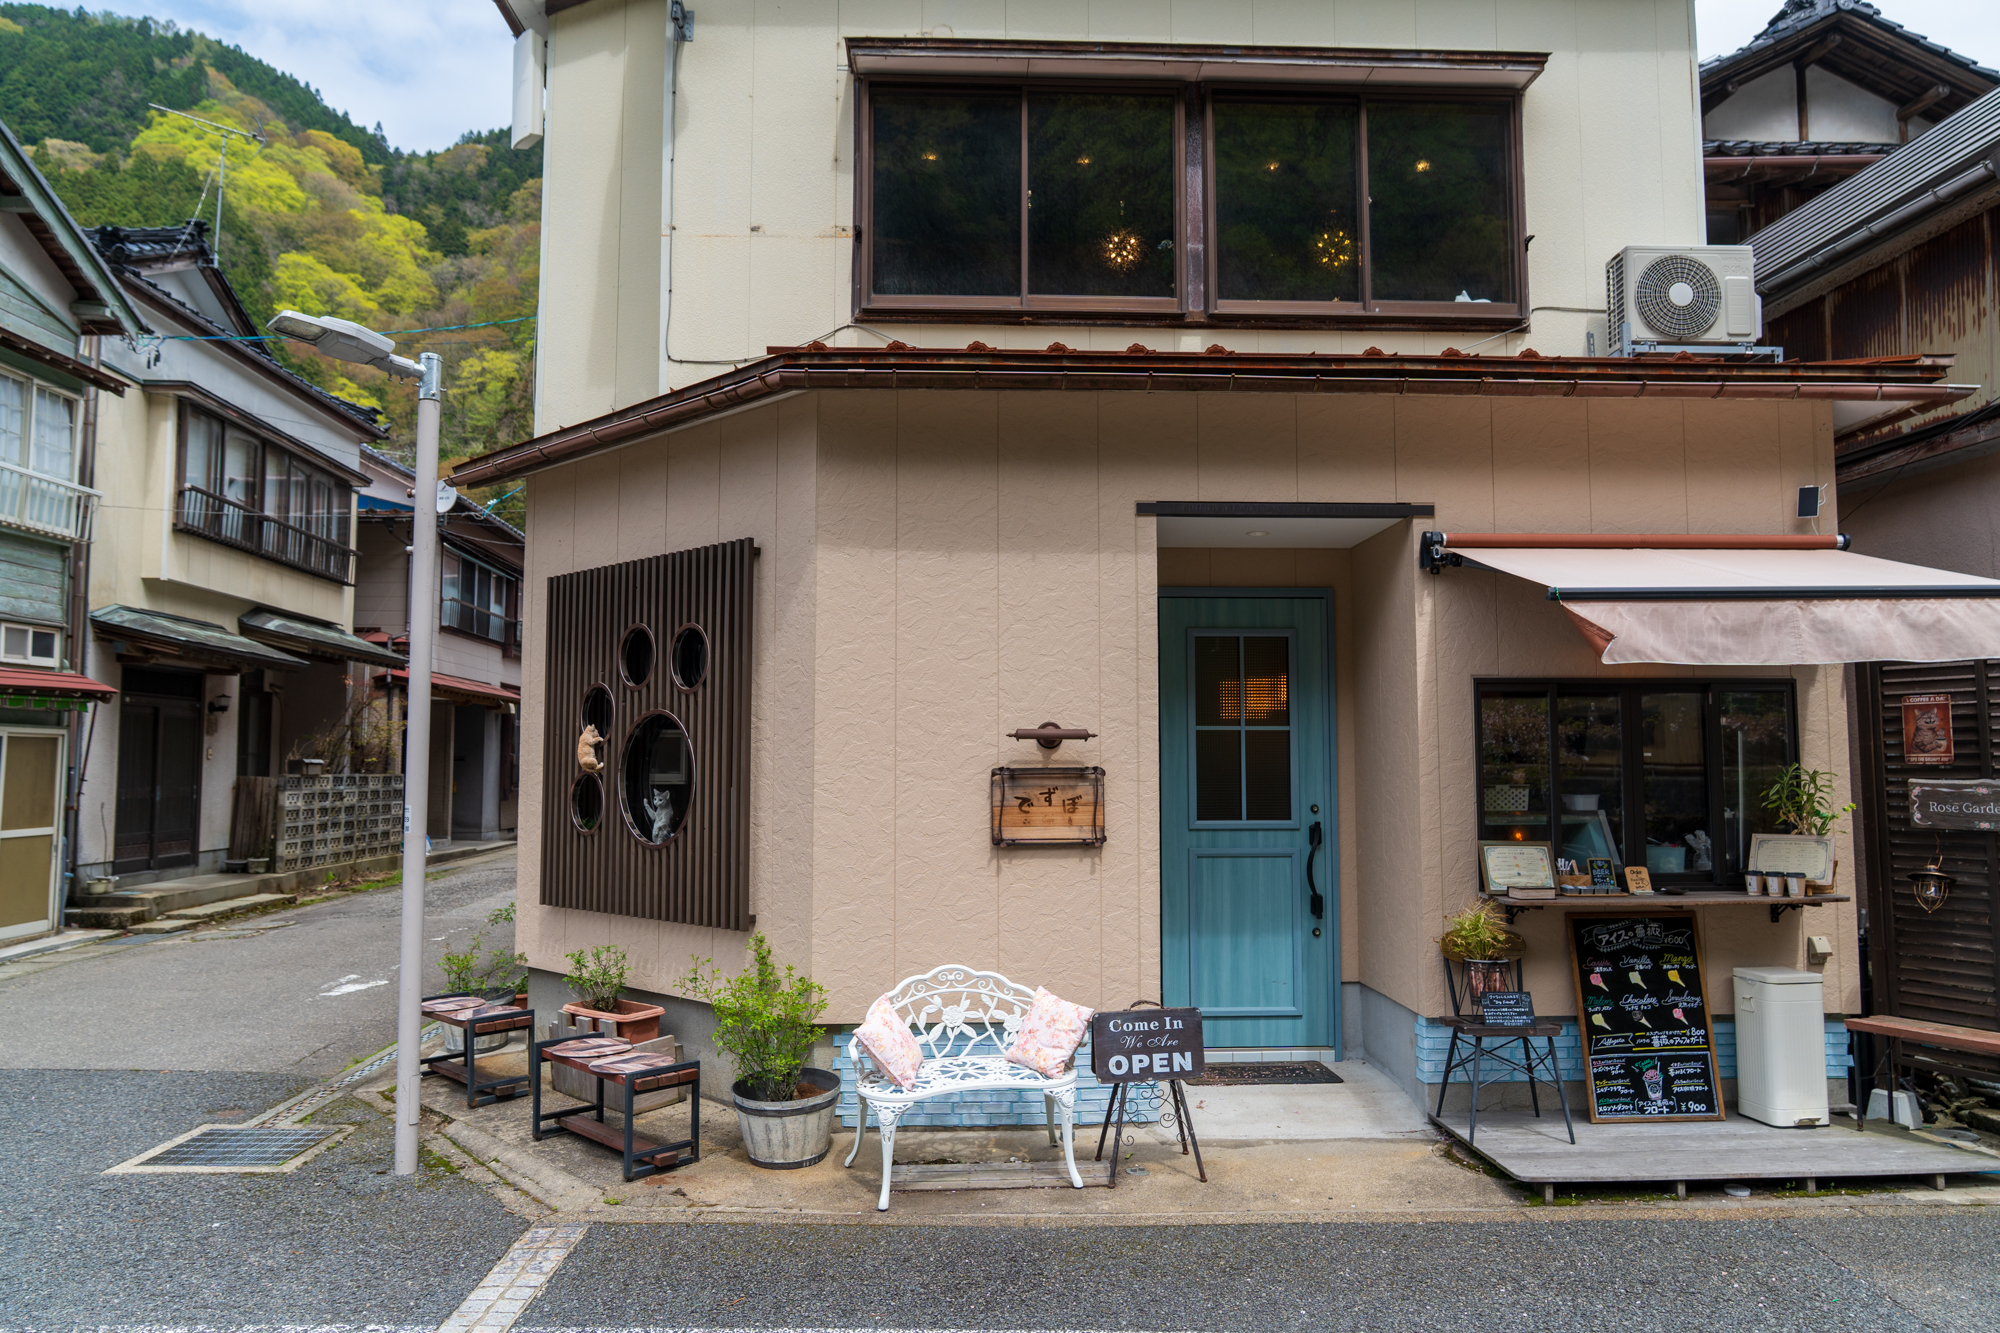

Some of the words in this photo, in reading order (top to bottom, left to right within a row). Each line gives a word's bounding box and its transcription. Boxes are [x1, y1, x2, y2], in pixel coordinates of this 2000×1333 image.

[1929, 801, 1959, 813] Rose
[1598, 924, 1661, 945] アイスの薔薇
[1664, 935, 1684, 945] ¥600
[1621, 955, 1652, 966] Vanilla
[1661, 954, 1694, 966] Mango
[1586, 995, 1613, 1006] Melon
[1621, 993, 1658, 1005] Chocolate
[1108, 1019, 1159, 1033] Come
[1164, 1016, 1184, 1030] In
[1120, 1034, 1143, 1049] We
[1147, 1033, 1179, 1048] Are
[1108, 1051, 1193, 1075] OPEN
[1643, 1106, 1670, 1114] フロート
[1681, 1101, 1707, 1112] ¥900
